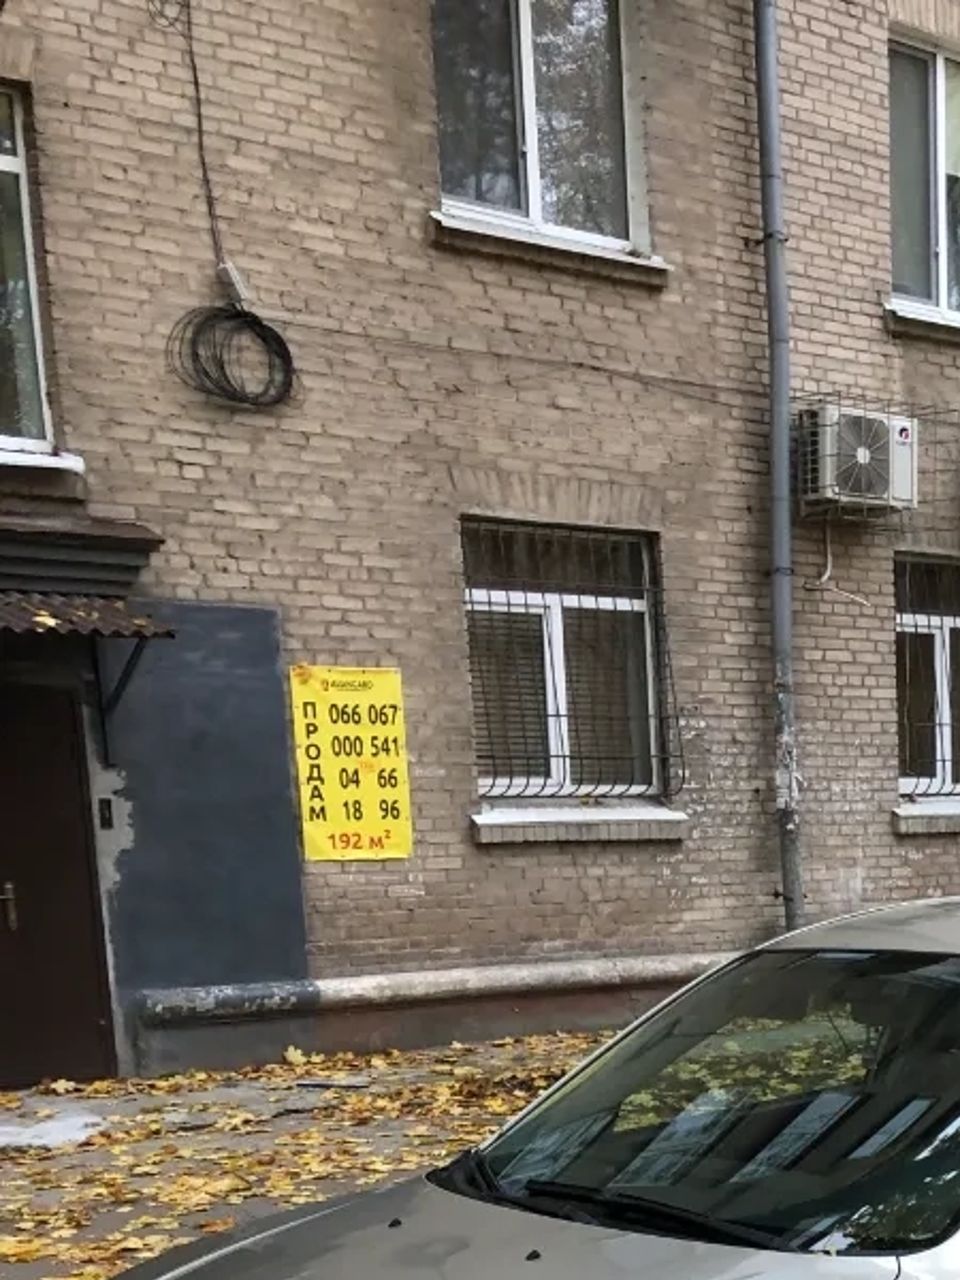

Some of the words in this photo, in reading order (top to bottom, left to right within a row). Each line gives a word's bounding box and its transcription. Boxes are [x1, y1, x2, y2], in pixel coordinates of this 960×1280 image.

[328, 703, 362, 725] 066
[368, 703, 398, 725] 067
[331, 735, 364, 757] 000
[370, 735, 400, 757] 541
[302, 701, 327, 822] ПРОДАМ
[338, 767, 360, 789] 04
[377, 768, 398, 789] 66
[343, 799, 363, 820] 18
[379, 799, 400, 820] 96
[327, 833, 364, 850] 192
